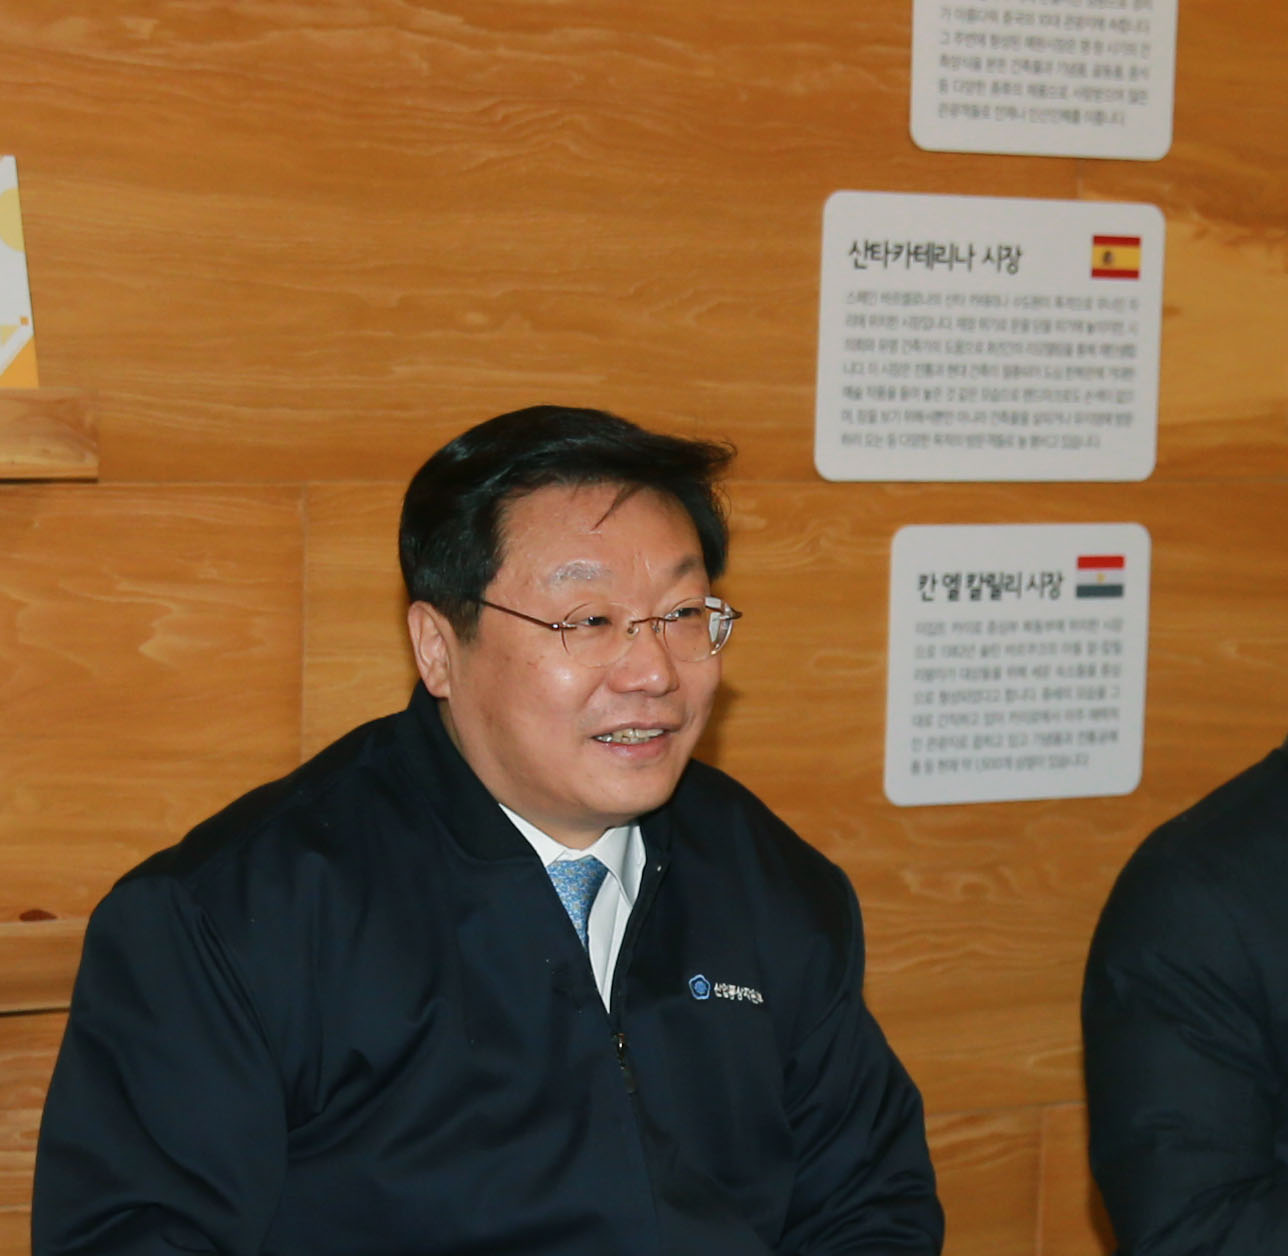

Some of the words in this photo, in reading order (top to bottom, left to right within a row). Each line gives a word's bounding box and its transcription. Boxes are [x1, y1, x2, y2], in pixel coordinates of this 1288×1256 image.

[848, 240, 974, 272] 산타카테리나
[982, 244, 1023, 275] 시장
[917, 572, 937, 602] 칸
[1026, 571, 1064, 600] 시장
